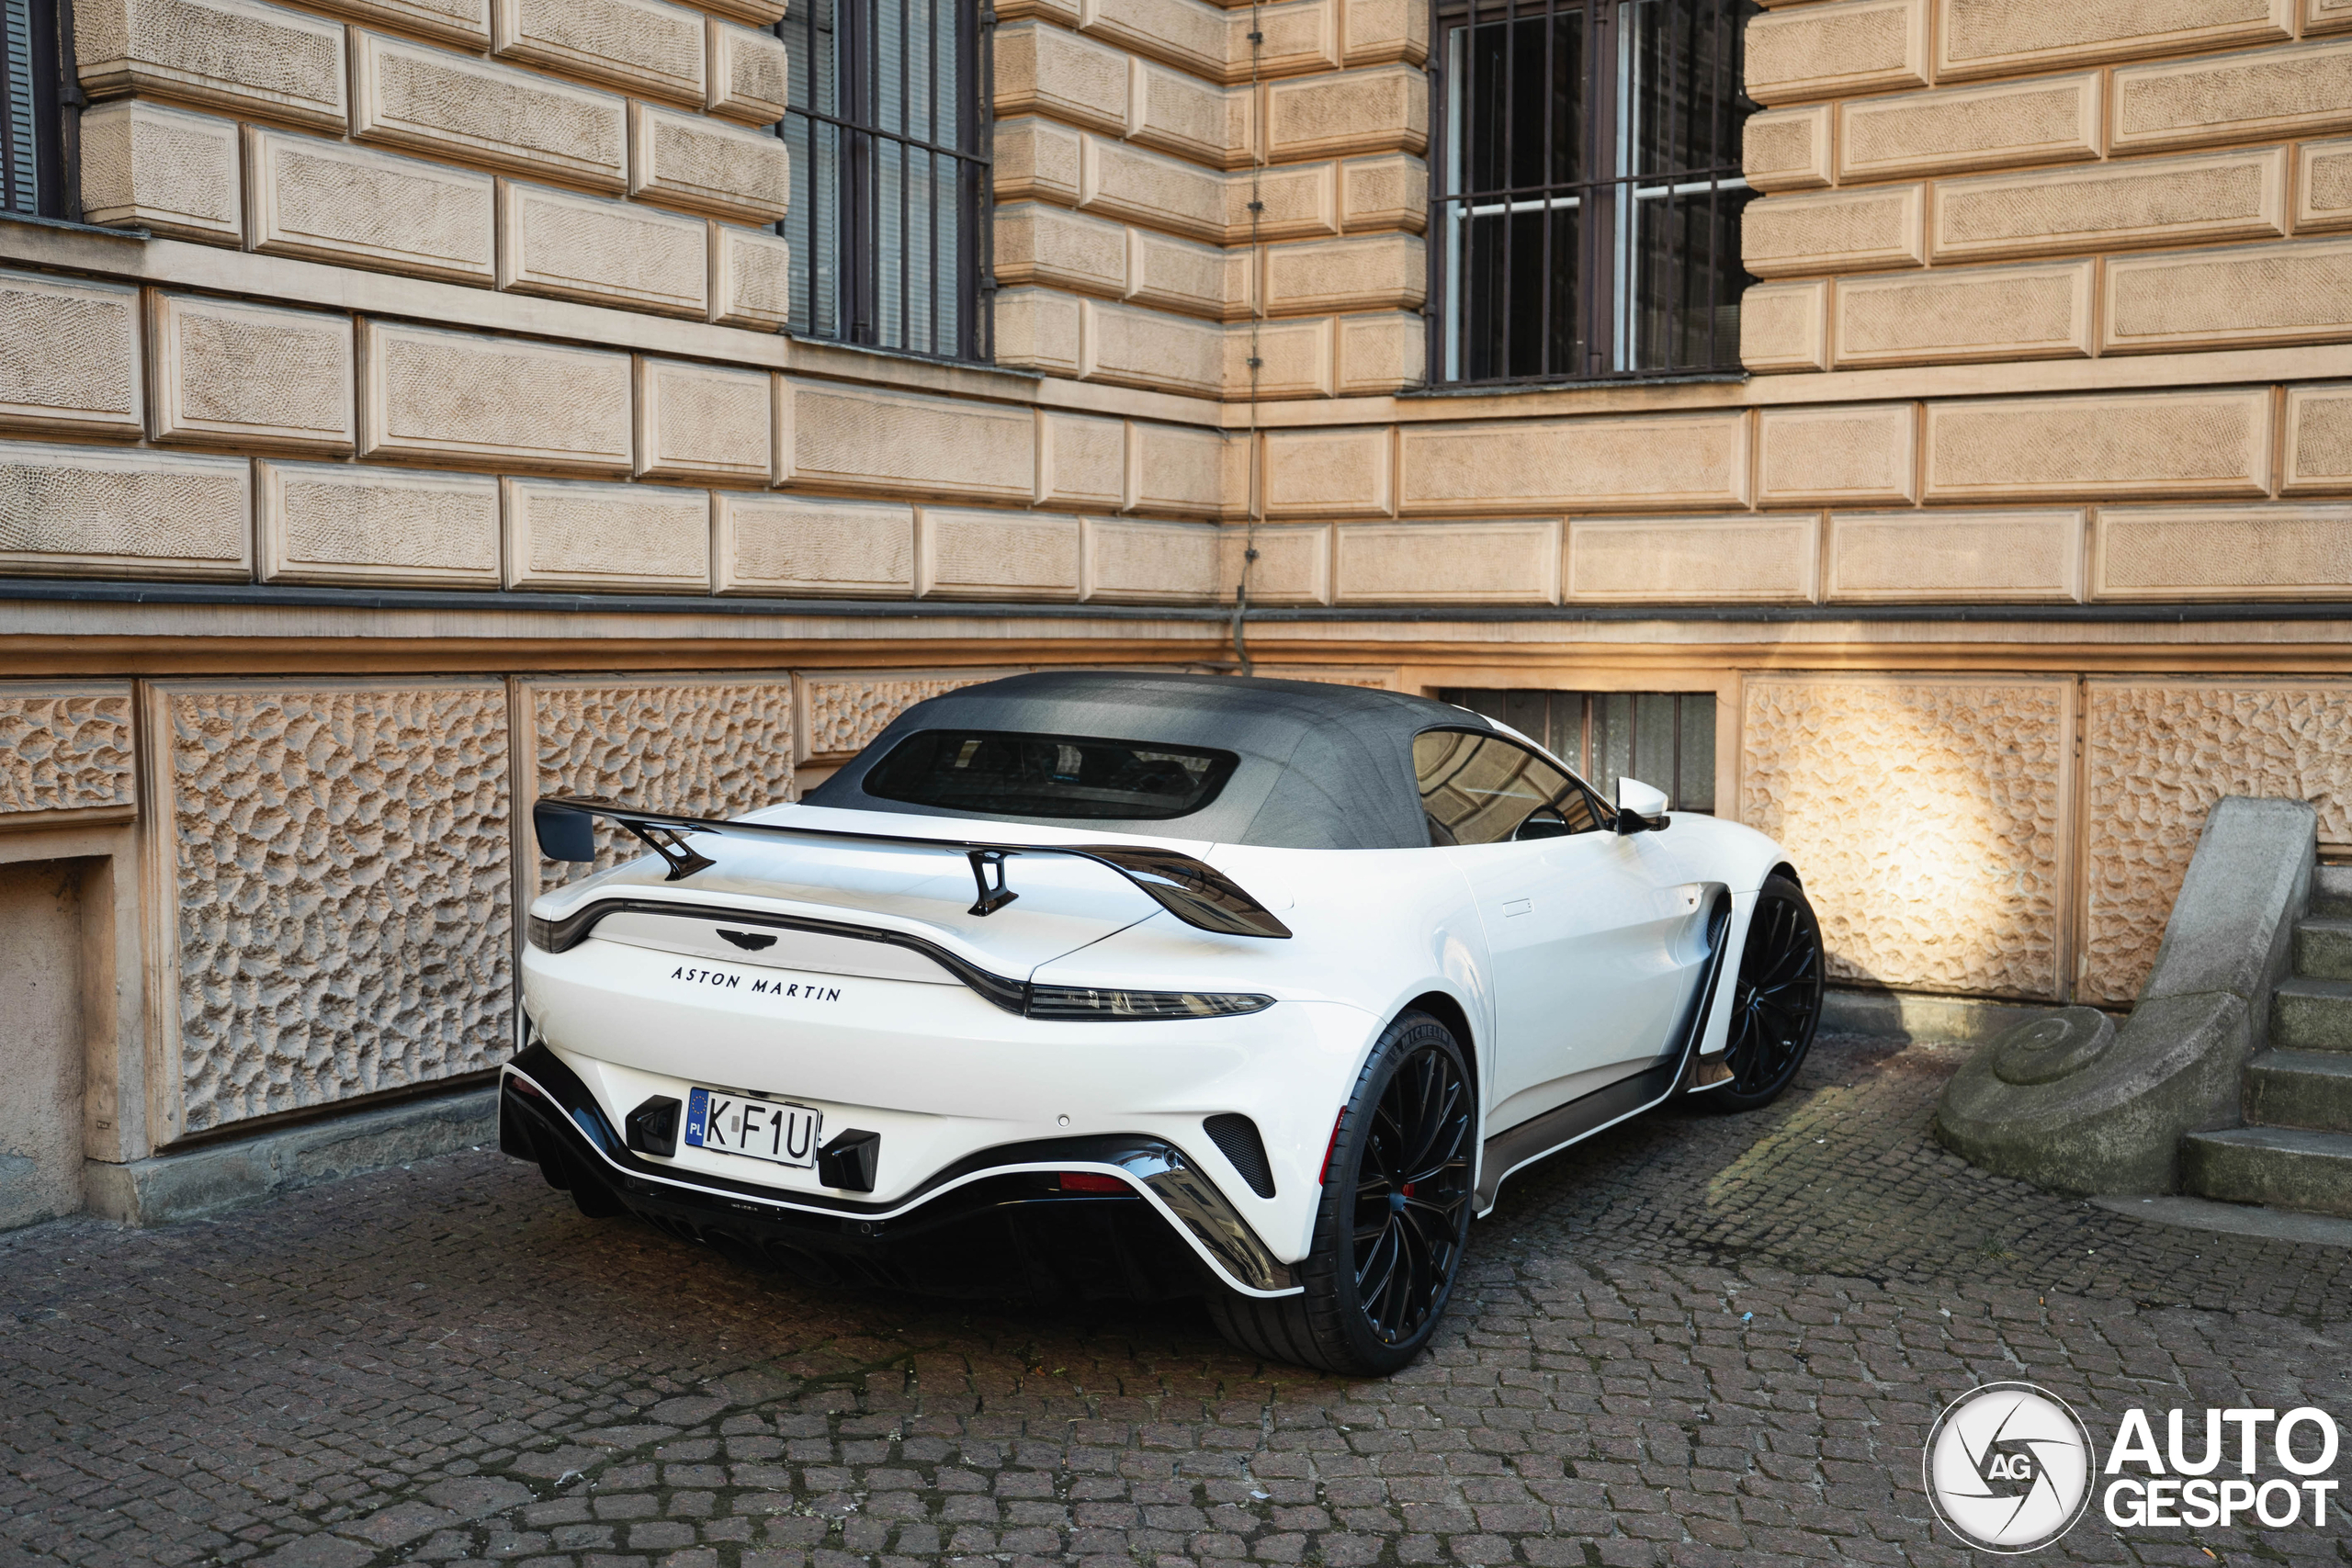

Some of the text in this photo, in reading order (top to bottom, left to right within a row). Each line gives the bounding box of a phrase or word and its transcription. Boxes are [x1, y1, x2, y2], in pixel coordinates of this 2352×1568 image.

[672, 966, 841, 1002] ASTON MARTIN
[1401, 1025, 1449, 1049] MICHELIN
[689, 1122, 703, 1136] PL
[707, 1098, 812, 1158] K F1U
